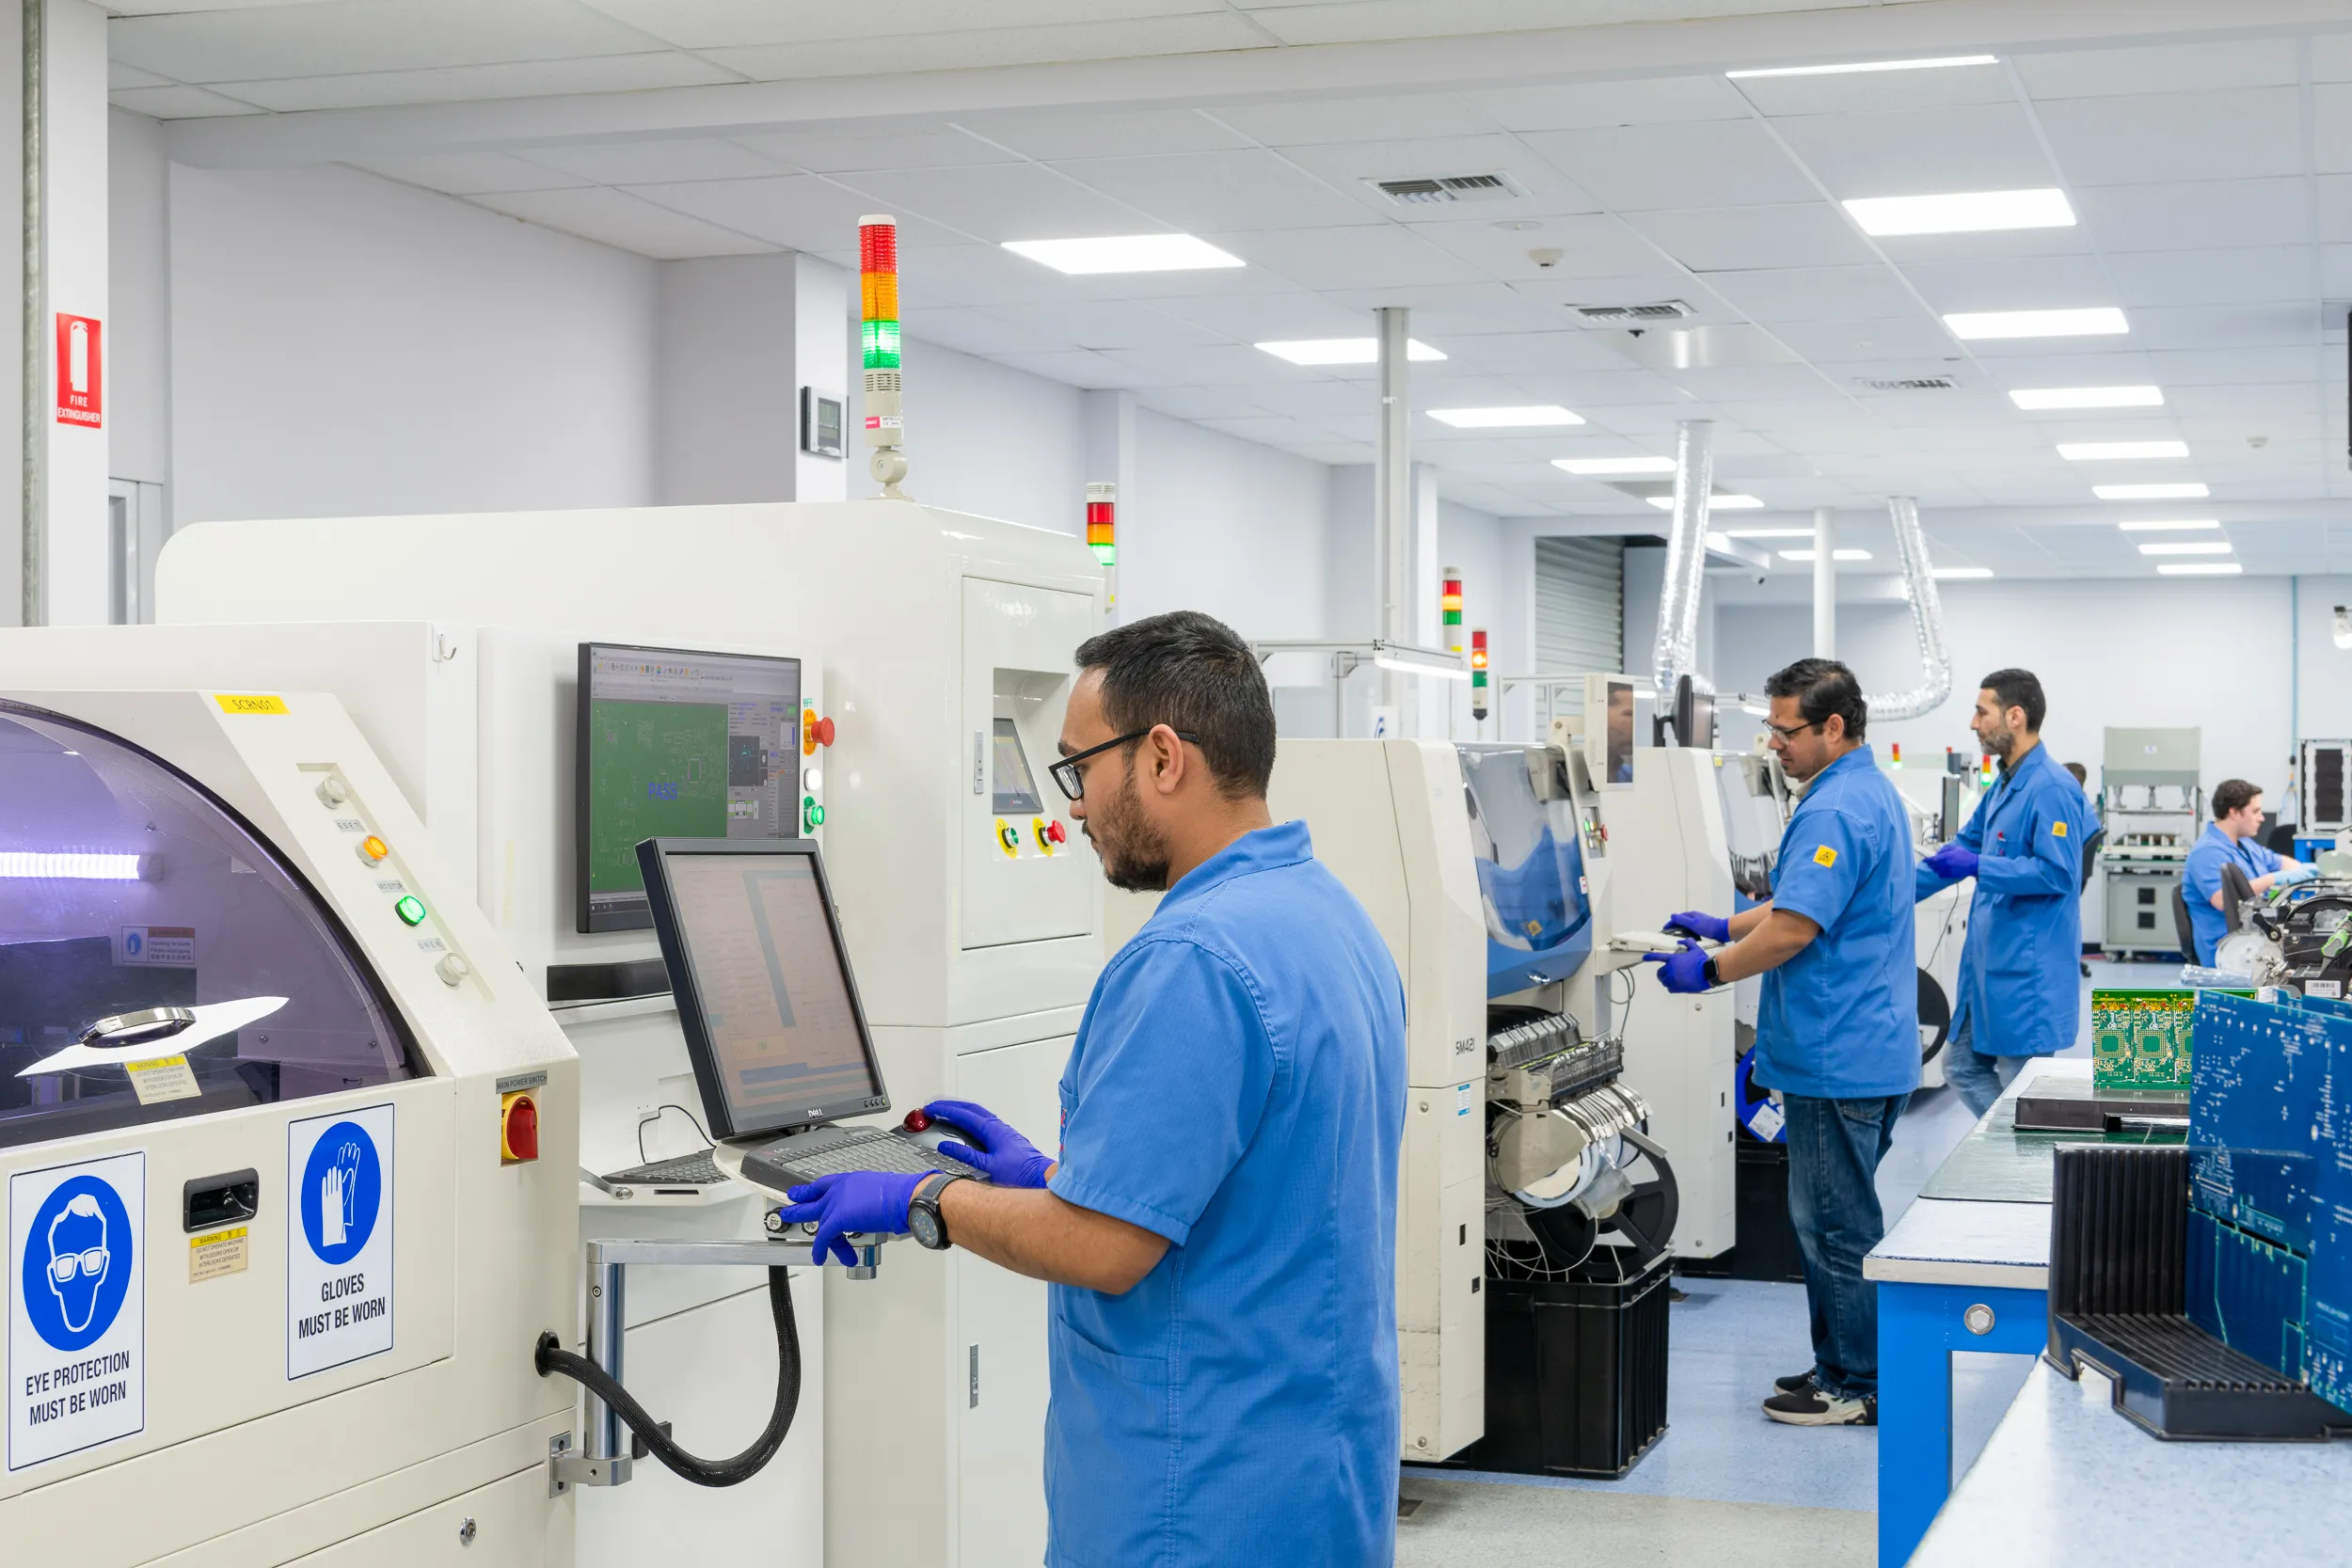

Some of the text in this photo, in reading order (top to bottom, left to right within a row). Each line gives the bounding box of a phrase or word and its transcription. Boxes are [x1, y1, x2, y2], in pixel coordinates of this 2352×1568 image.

[70, 394, 88, 407] FIRE
[57, 407, 101, 423] EXTINGUISHER
[231, 699, 275, 710] SCRN01
[648, 782, 677, 800] PASS
[497, 1074, 547, 1090] MAIN POWER SWITCH
[807, 1108, 824, 1117] DELL
[199, 1234, 222, 1243] WARNING
[211, 1242, 228, 1250] OPERATE
[321, 1273, 364, 1303] GLOVES
[298, 1296, 386, 1339] MUST BE WORN
[25, 1350, 130, 1397] EYE PROTECTION
[29, 1380, 126, 1426] MUST BE WORN
